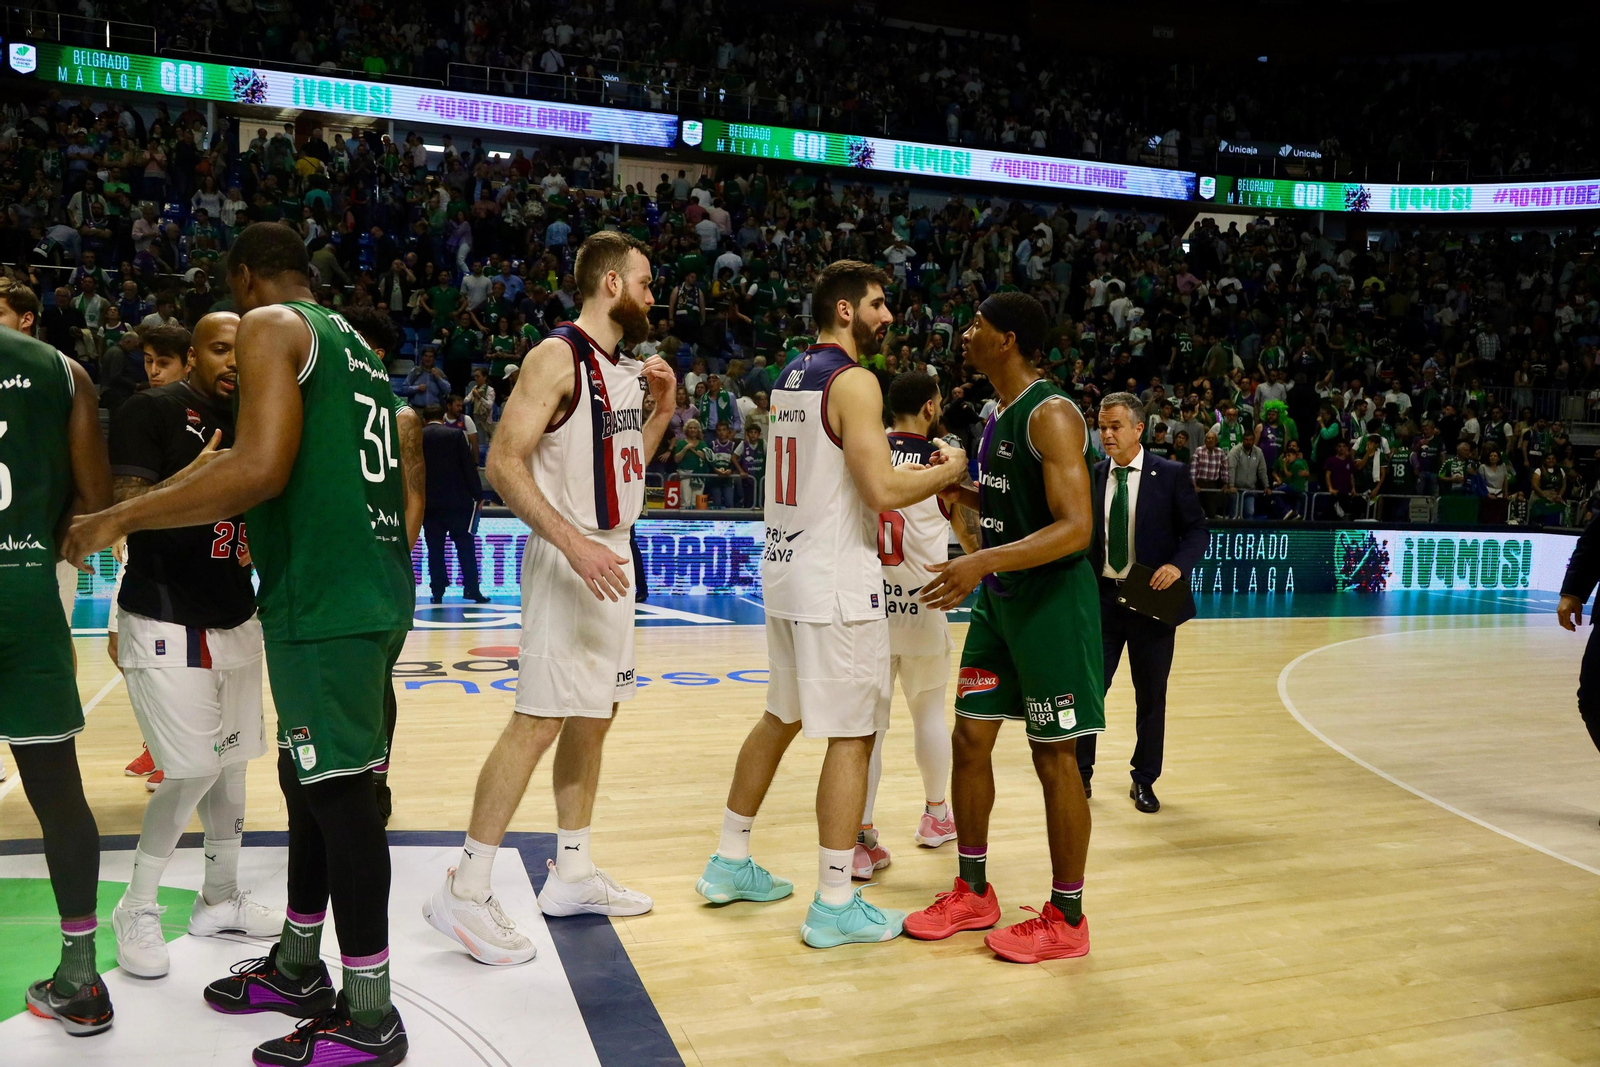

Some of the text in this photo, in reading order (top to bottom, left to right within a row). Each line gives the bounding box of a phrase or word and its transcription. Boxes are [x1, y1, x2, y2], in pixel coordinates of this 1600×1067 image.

[73, 50, 129, 71] BELGRADO
[58, 66, 143, 90] MÁLAGA
[160, 61, 204, 95] GO!
[292, 76, 392, 115] ¡VAMOS!
[416, 94, 593, 133] #ROADTOBELGRADE
[729, 123, 771, 141] BELGRADO
[716, 138, 780, 158] MÁLAGA
[793, 131, 827, 161] GO!
[1228, 145, 1258, 155] Unicaja
[1293, 149, 1322, 159] Unicaja
[894, 144, 972, 177] ¡VAMOS!
[990, 157, 1128, 189] #ROADTOBELGRADE
[1237, 179, 1274, 193] BELGRADO
[1293, 183, 1325, 208] GO!
[1493, 184, 1600, 207] #ROADTOBE
[1227, 191, 1282, 208] MÁLAGA
[1389, 186, 1473, 211] ¡VAMOS!
[1179, 340, 1193, 352] 20
[778, 409, 806, 422] AMUTIO
[354, 392, 398, 483] 31
[621, 446, 643, 483] 24
[890, 450, 921, 467] WARD
[1391, 463, 1406, 478] 18
[775, 436, 797, 507] 11
[667, 487, 679, 507] 5
[877, 510, 905, 566] 0
[1204, 533, 1289, 560] BELGRADO
[1402, 536, 1533, 589] ¡VAMOS!
[1190, 561, 1295, 593] MÁLAGA
[1029, 697, 1055, 712] má
[1027, 708, 1056, 726] laga
